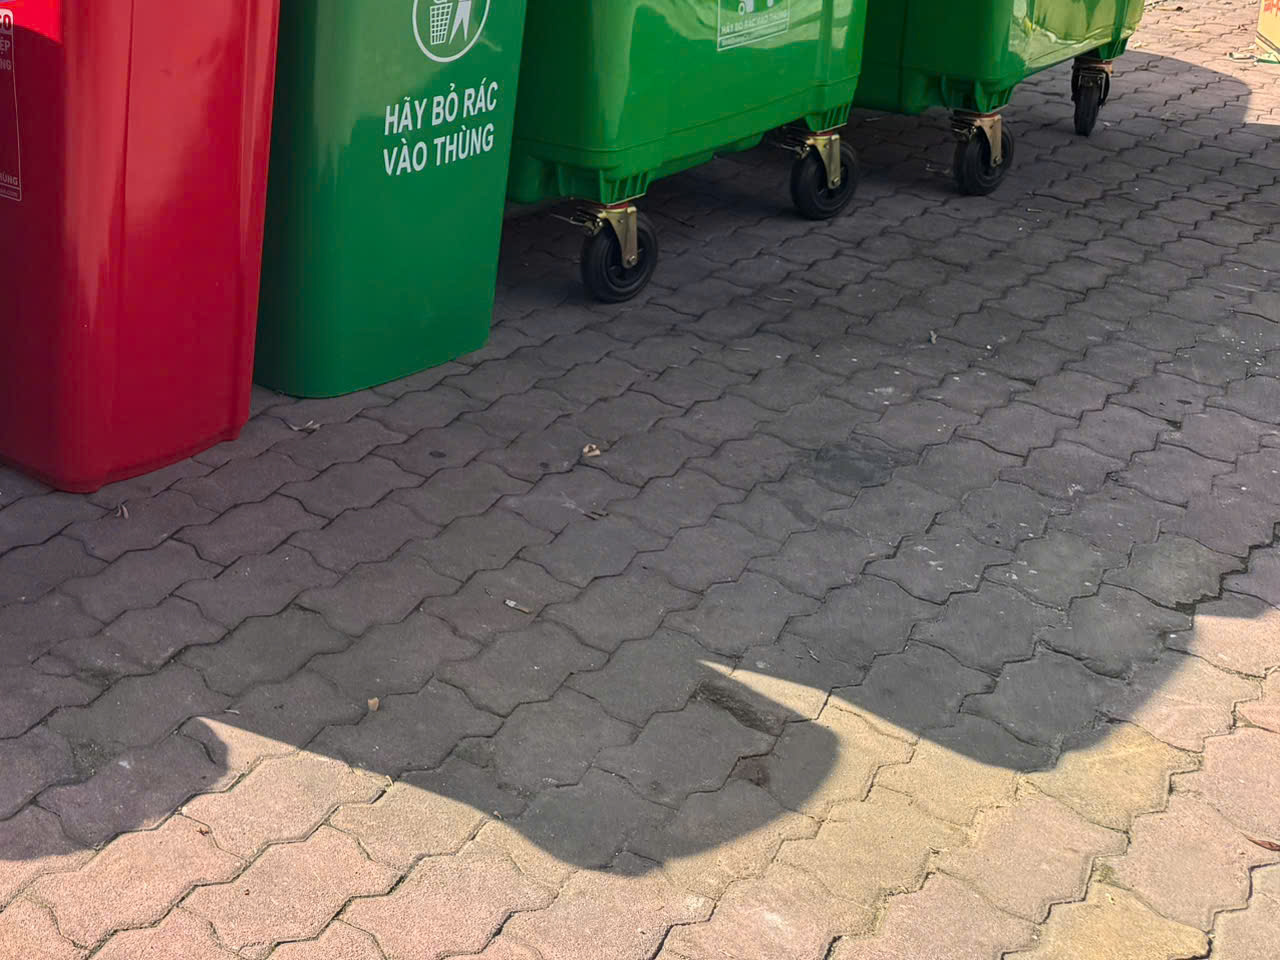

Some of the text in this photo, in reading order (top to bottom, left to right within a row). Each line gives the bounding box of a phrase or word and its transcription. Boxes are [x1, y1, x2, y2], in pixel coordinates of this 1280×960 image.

[384, 77, 498, 136] HÃY BỎ RÁC
[383, 123, 494, 176] VÀO THÙNG
